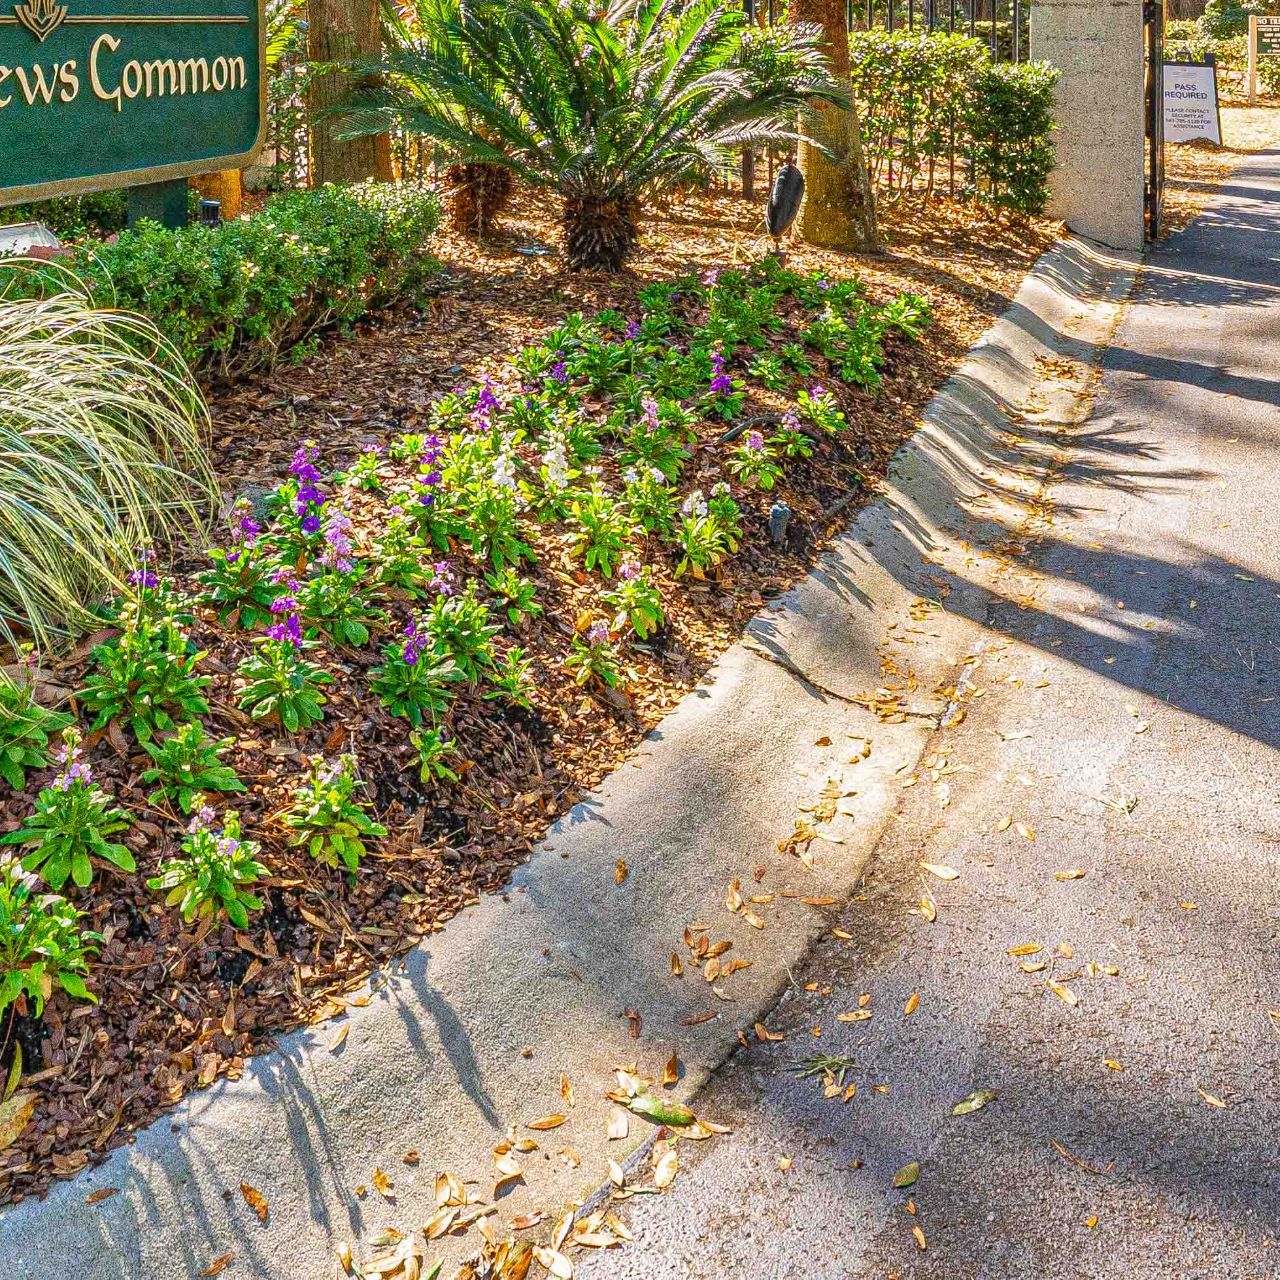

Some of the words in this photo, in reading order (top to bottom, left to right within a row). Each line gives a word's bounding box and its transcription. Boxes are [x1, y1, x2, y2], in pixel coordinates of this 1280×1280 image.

[89, 33, 248, 112] Common
[1174, 83, 1197, 91] PASS
[1164, 91, 1208, 100] REQUIRED
